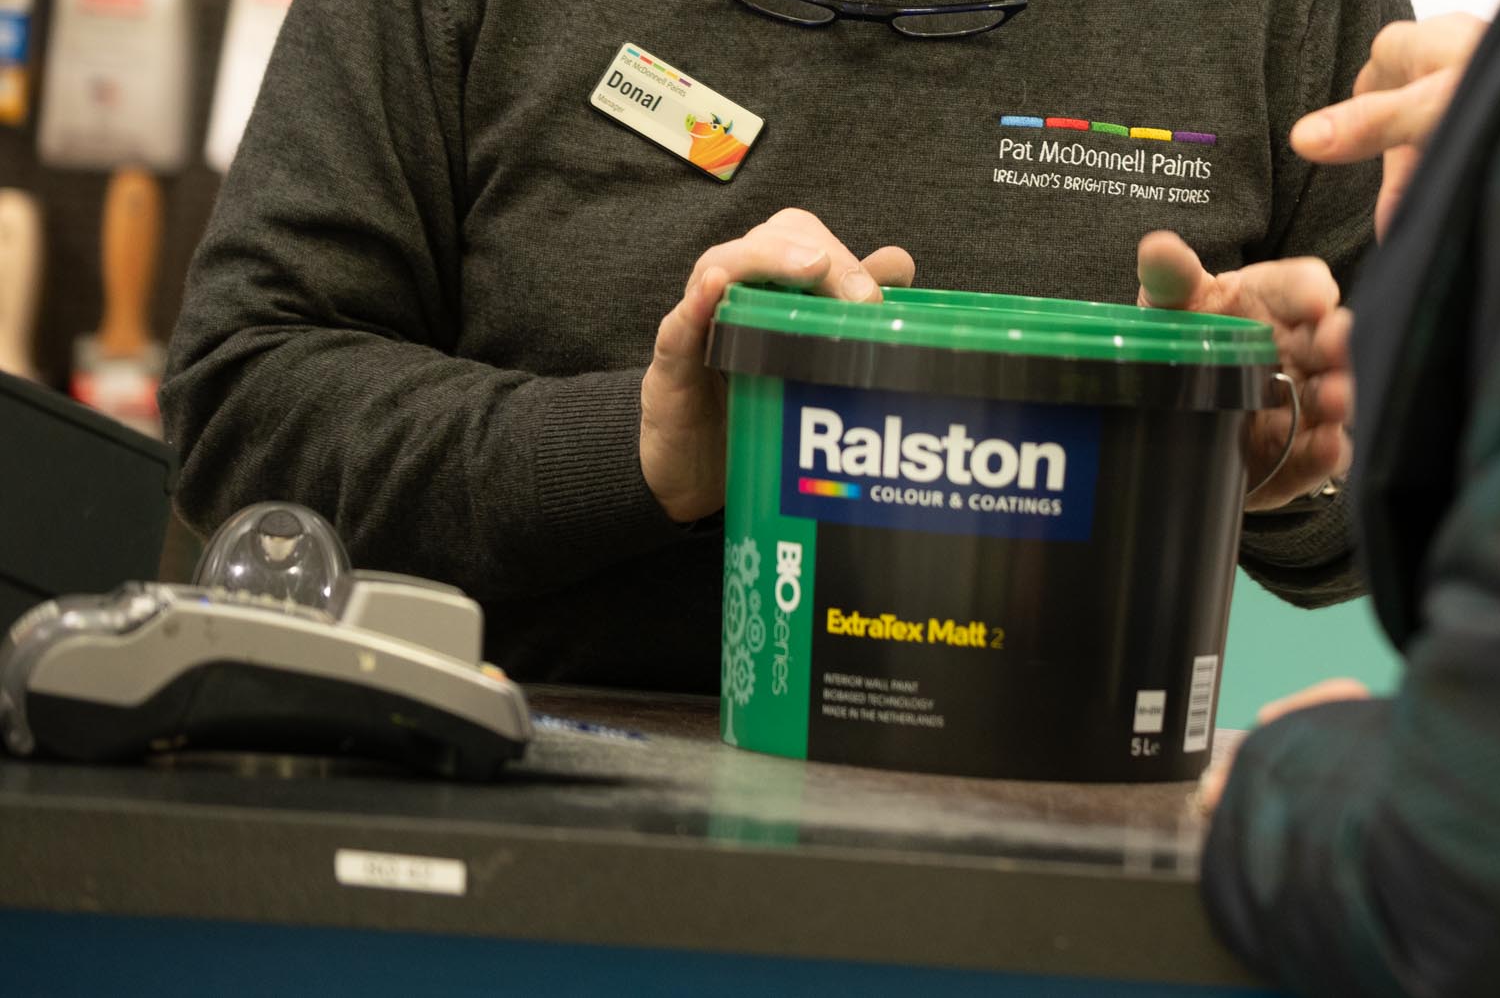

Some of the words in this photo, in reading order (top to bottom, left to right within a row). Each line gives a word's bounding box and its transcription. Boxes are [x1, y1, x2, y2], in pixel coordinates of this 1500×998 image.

[606, 69, 662, 112] Donal
[632, 61, 668, 86] McDonnell
[666, 81, 687, 98] Paints
[1000, 138, 1033, 161] Pat
[1038, 141, 1145, 173] McDonnell
[1151, 153, 1212, 179] Paints
[993, 168, 1061, 189] IRELAND'S
[1063, 176, 1126, 196] BRIGHTEST
[1130, 183, 1165, 201] PAINT
[1168, 187, 1211, 204] STORES
[799, 406, 1066, 491] Ralston
[870, 484, 944, 508] COLOUR
[949, 491, 963, 510] &
[968, 493, 1062, 516] COATINGS
[826, 607, 924, 643] ExtraTex
[927, 617, 987, 648] Matt
[990, 627, 1005, 649] 2
